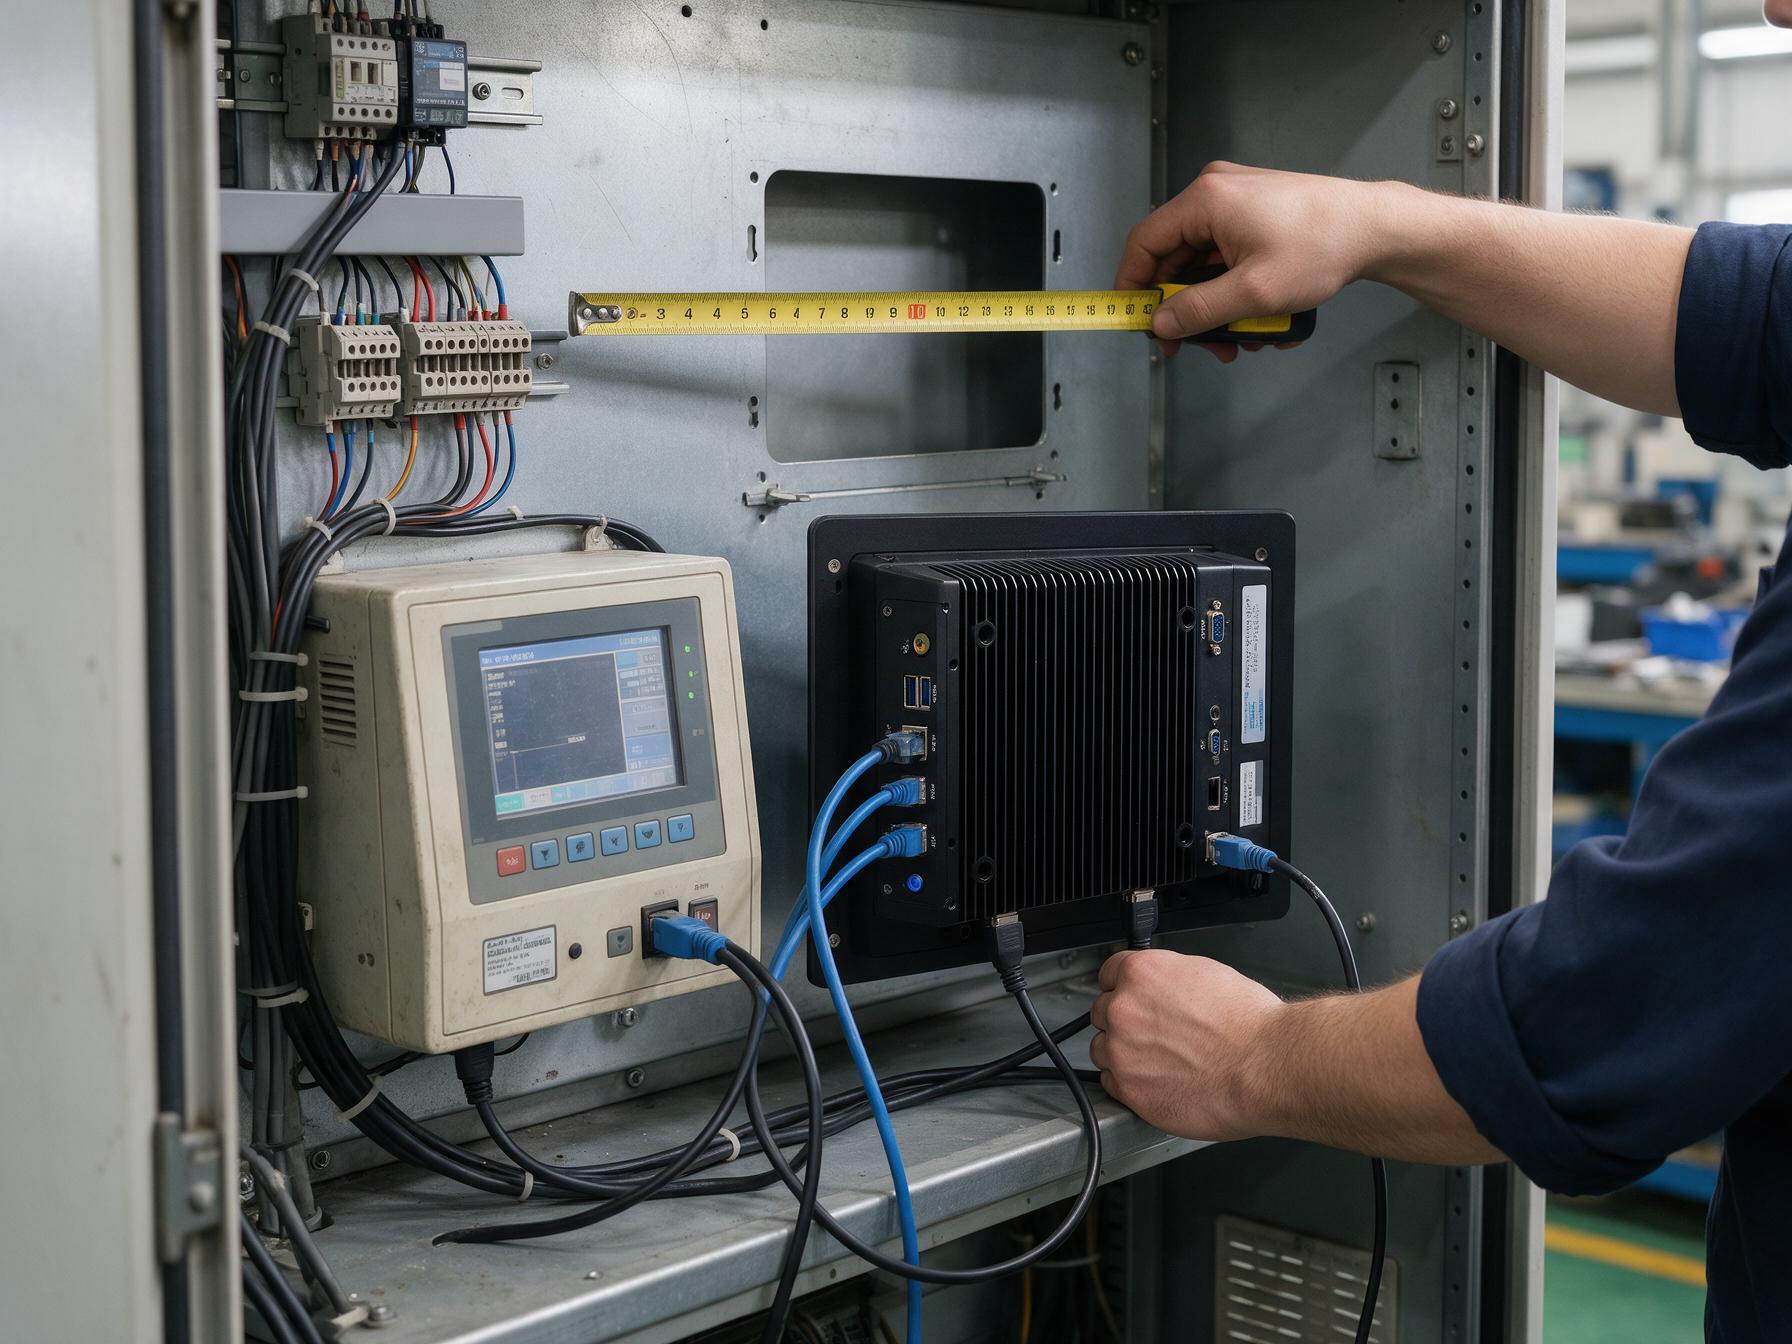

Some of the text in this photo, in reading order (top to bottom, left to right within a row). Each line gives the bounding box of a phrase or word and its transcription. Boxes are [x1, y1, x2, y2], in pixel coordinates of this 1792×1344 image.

[656, 308, 665, 320] 3
[684, 308, 693, 320] 4
[713, 308, 721, 320] 4
[741, 308, 749, 320] 5
[769, 308, 777, 319] 6
[818, 308, 826, 319] 7
[841, 308, 849, 319] 8
